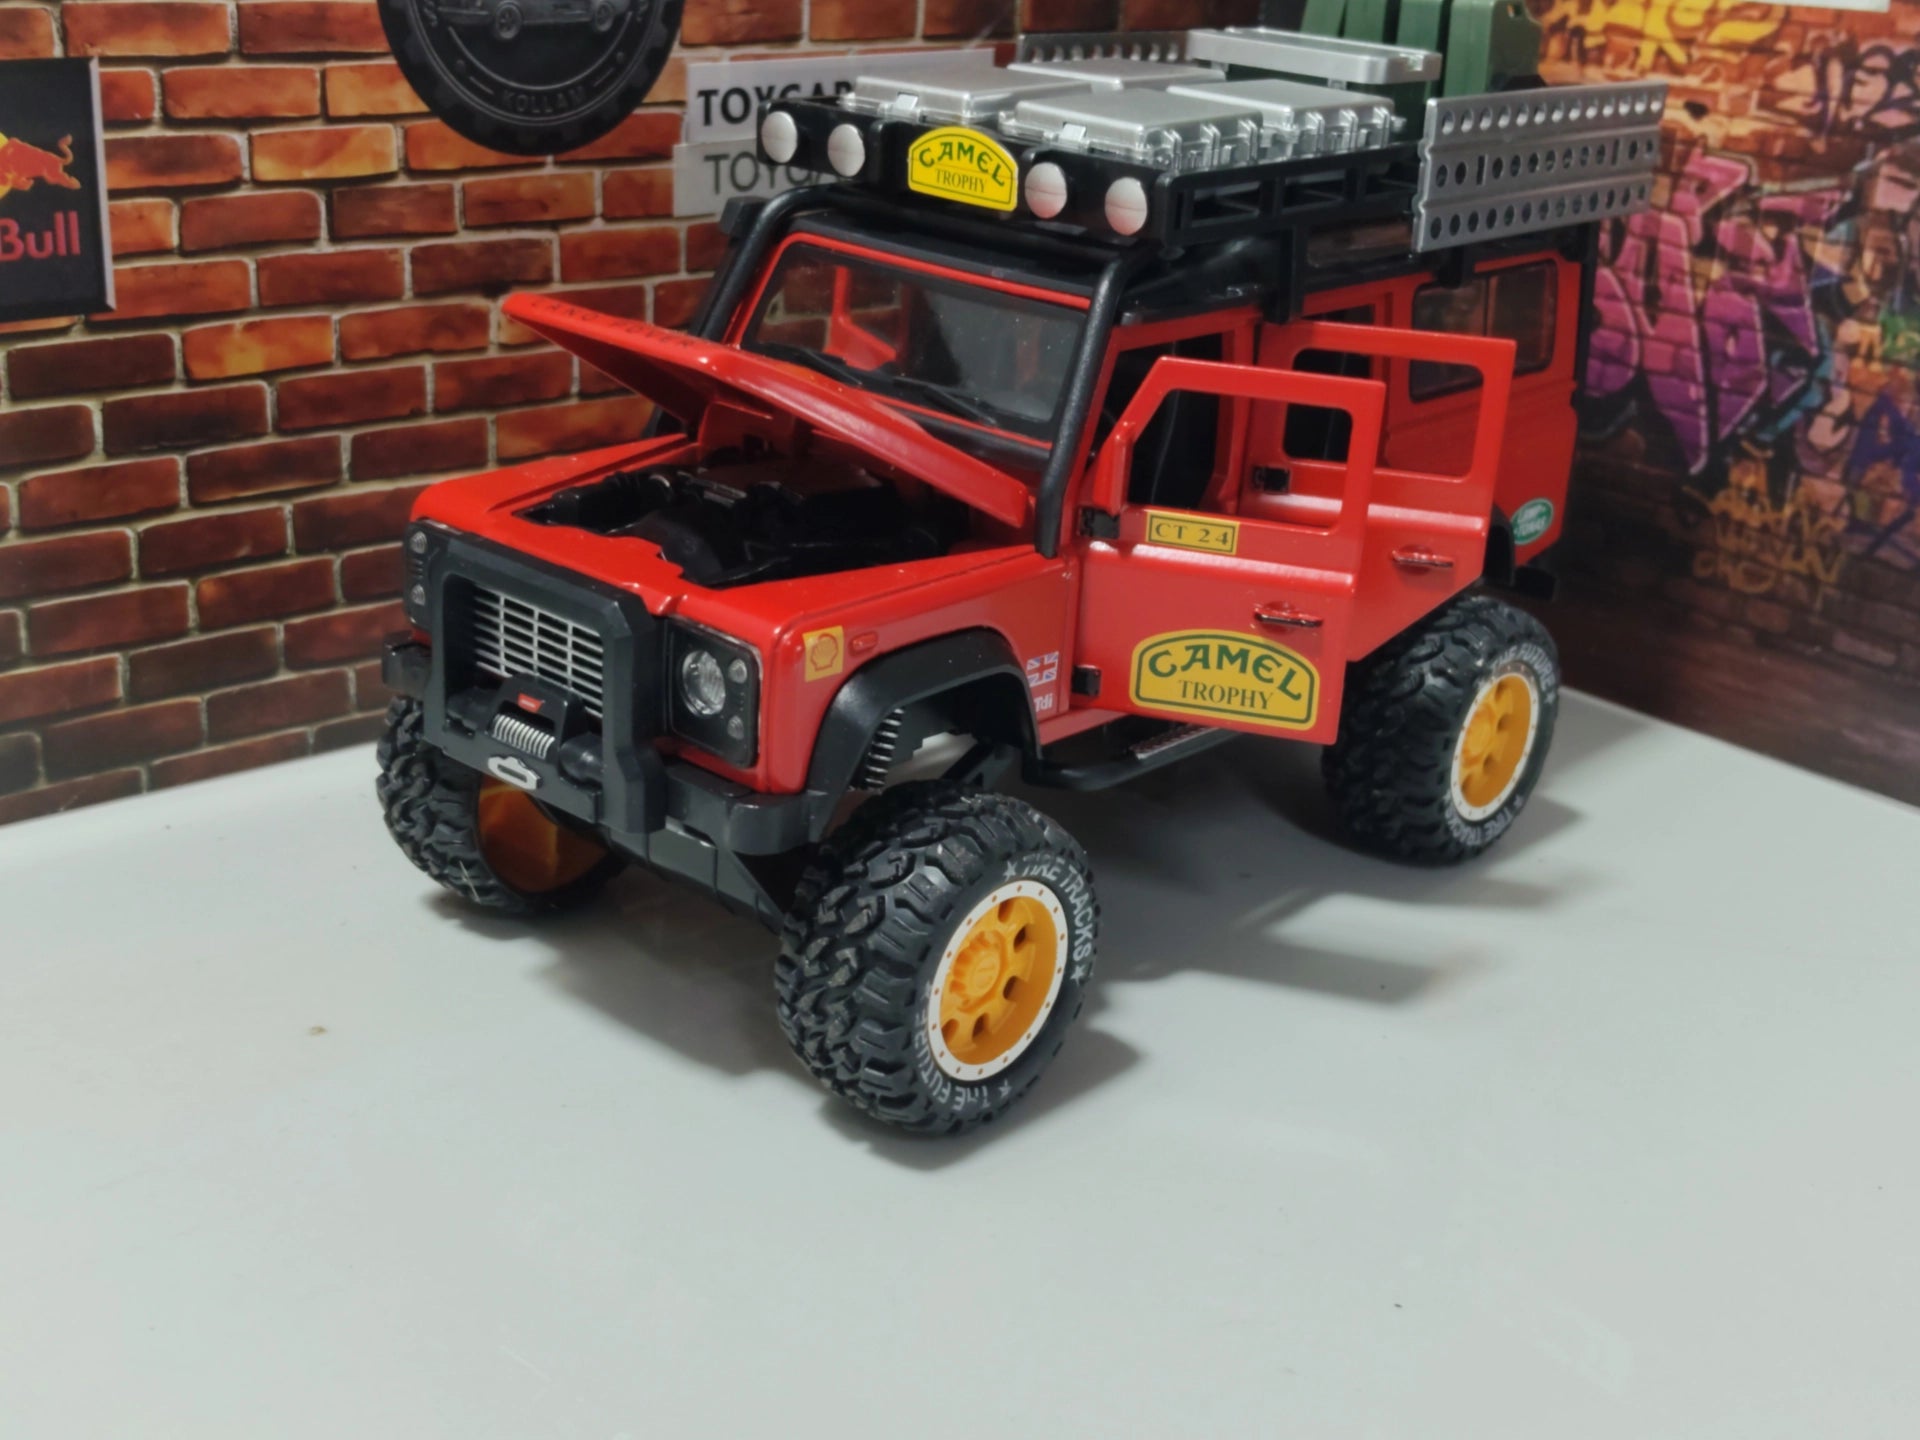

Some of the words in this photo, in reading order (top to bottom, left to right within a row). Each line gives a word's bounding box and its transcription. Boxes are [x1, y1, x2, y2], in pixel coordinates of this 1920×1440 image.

[704, 152, 822, 194] TOY
[919, 142, 1005, 187] CAMEL
[936, 168, 985, 193] TROPHY
[0, 211, 81, 261] Bull
[1155, 522, 1189, 540] CT
[1148, 644, 1302, 701] CAMEL
[1178, 679, 1275, 710] TROPHY
[1021, 850, 1067, 881] TIRE
[1060, 862, 1095, 962] TRACKS
[913, 1007, 952, 1105] FUTURE
[950, 1085, 992, 1111] THE
